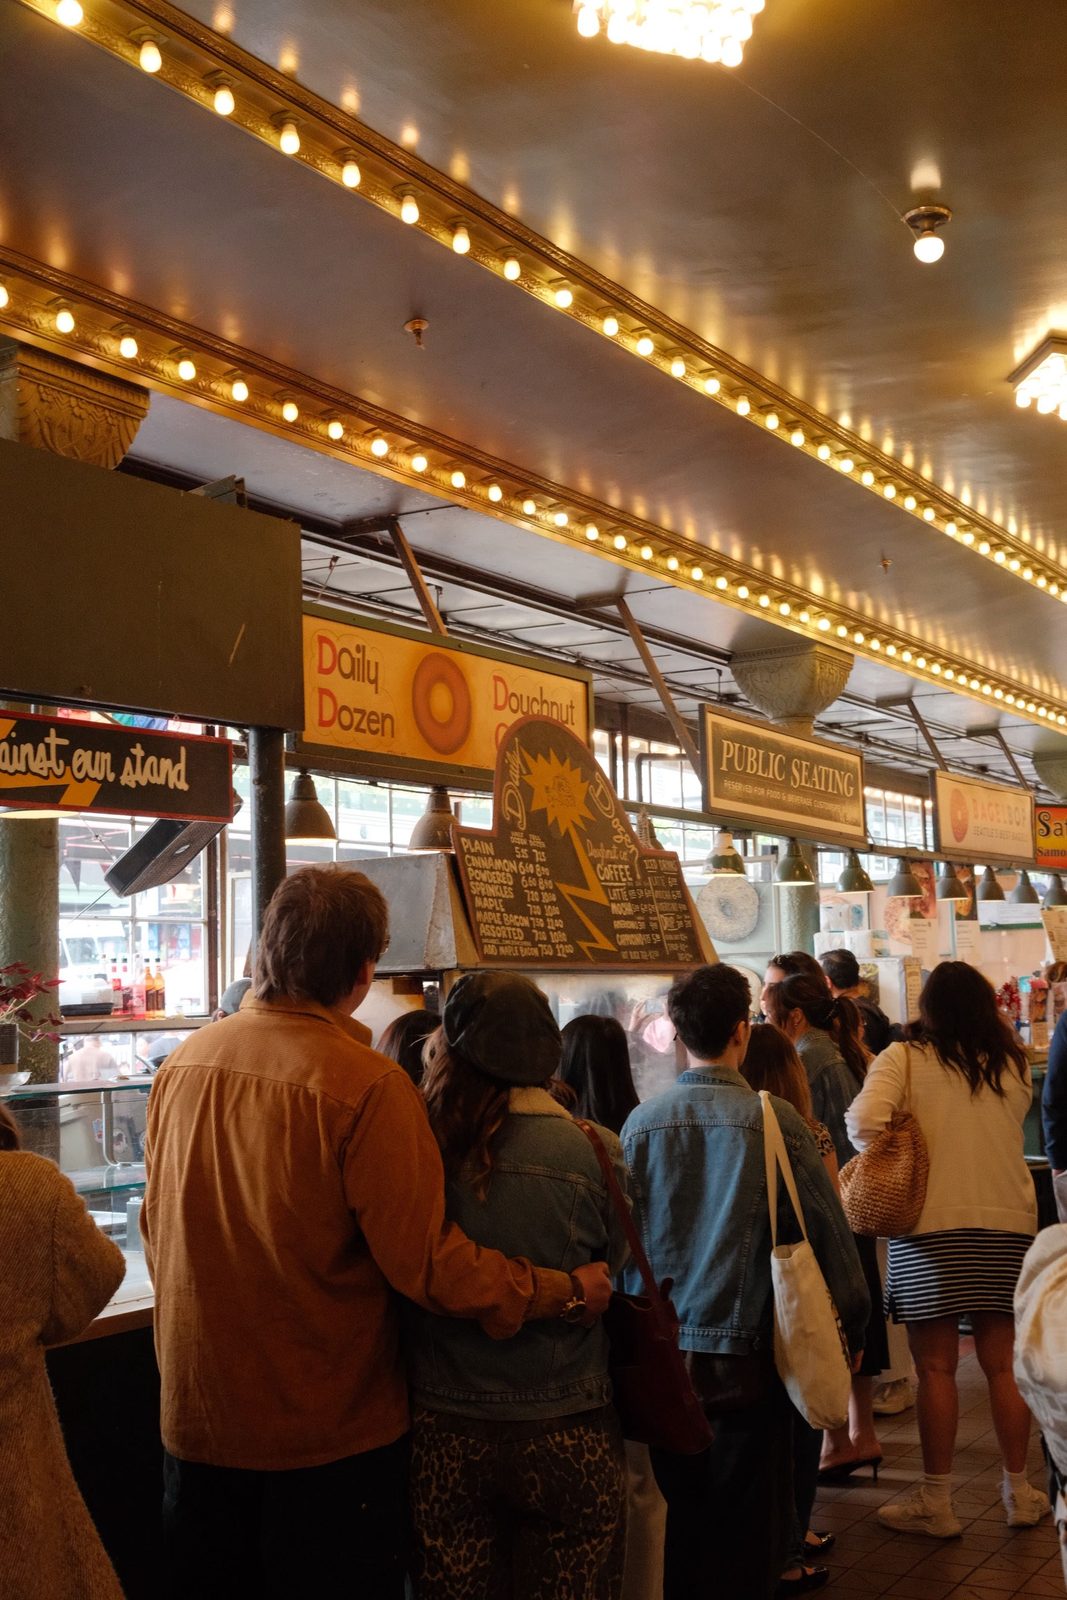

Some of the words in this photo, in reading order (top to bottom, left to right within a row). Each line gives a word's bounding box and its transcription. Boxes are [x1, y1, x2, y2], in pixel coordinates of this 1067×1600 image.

[317, 634, 379, 694] Daily
[317, 687, 395, 738] Dozen
[71, 747, 116, 783] our
[119, 743, 190, 792] stand
[720, 739, 786, 781] PUBLIC
[790, 758, 855, 798] SEATING
[461, 837, 495, 855] PLAIN
[465, 855, 518, 874] CINNAMON
[597, 863, 633, 881] COFFEE
[468, 867, 513, 886] POWDERED
[470, 881, 514, 899] SPRINKLES
[608, 887, 629, 901] LATTE
[475, 896, 505, 912] MAPLE
[476, 910, 502, 925] MAPLE
[503, 914, 530, 928] BACON
[480, 923, 524, 941] ASSORTED
